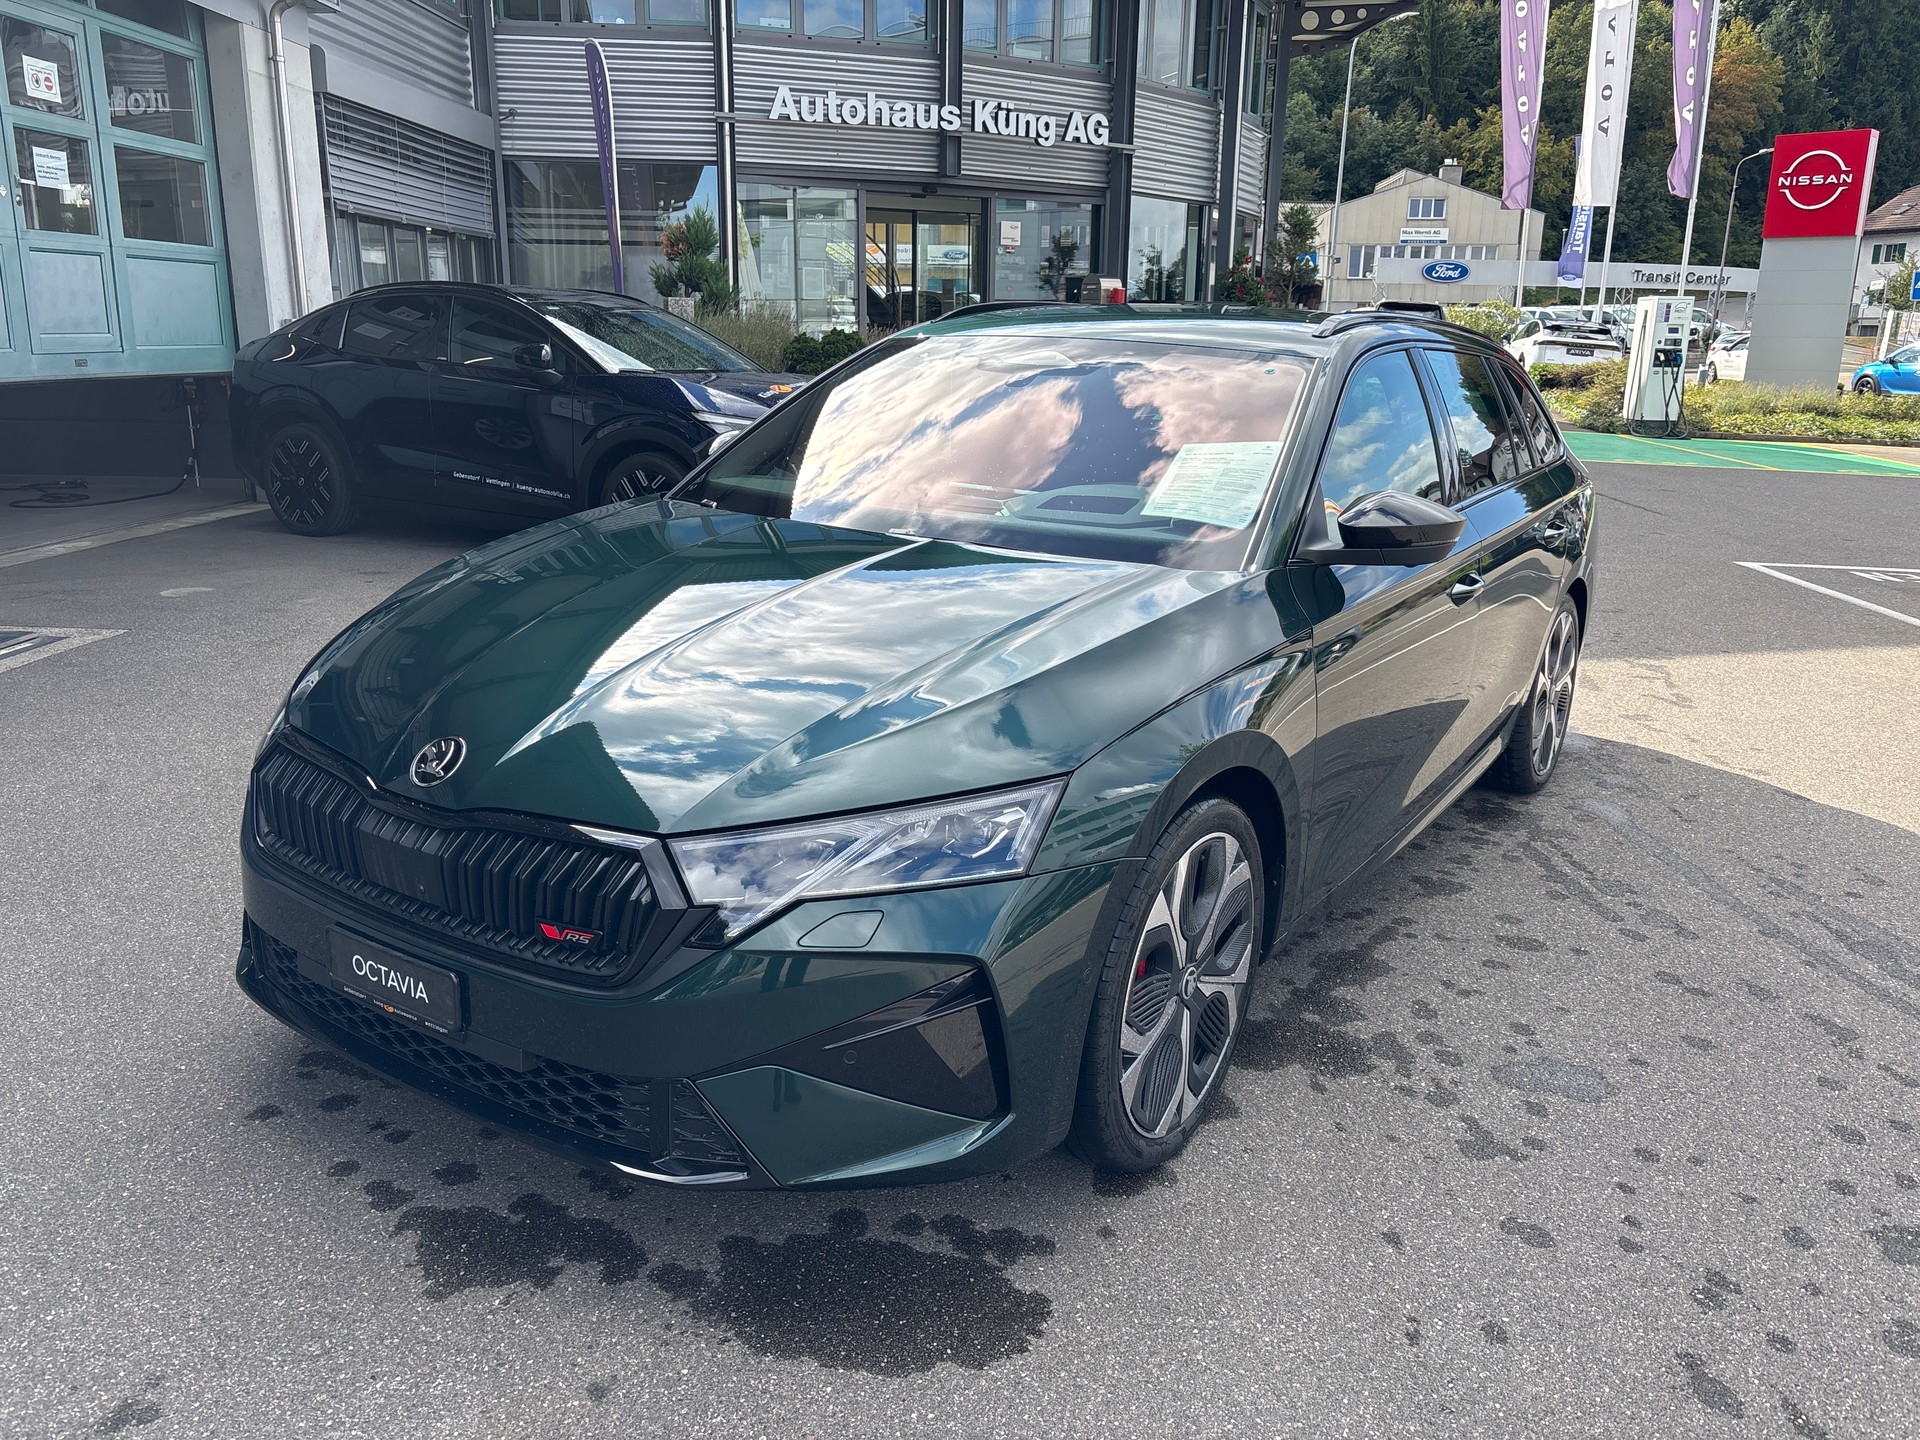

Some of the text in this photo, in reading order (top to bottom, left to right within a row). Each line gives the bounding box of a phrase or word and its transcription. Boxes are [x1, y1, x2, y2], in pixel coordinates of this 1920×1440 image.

[768, 85, 1110, 147] Autohaus Küng AG
[1777, 173, 1853, 187] NISSAN
[1432, 263, 1462, 278] Ford
[1634, 270, 1731, 285] Transit Center
[453, 471, 481, 482] Gebenstorf
[486, 477, 511, 488] Wettingen
[352, 954, 430, 1004] OCTAVIA
